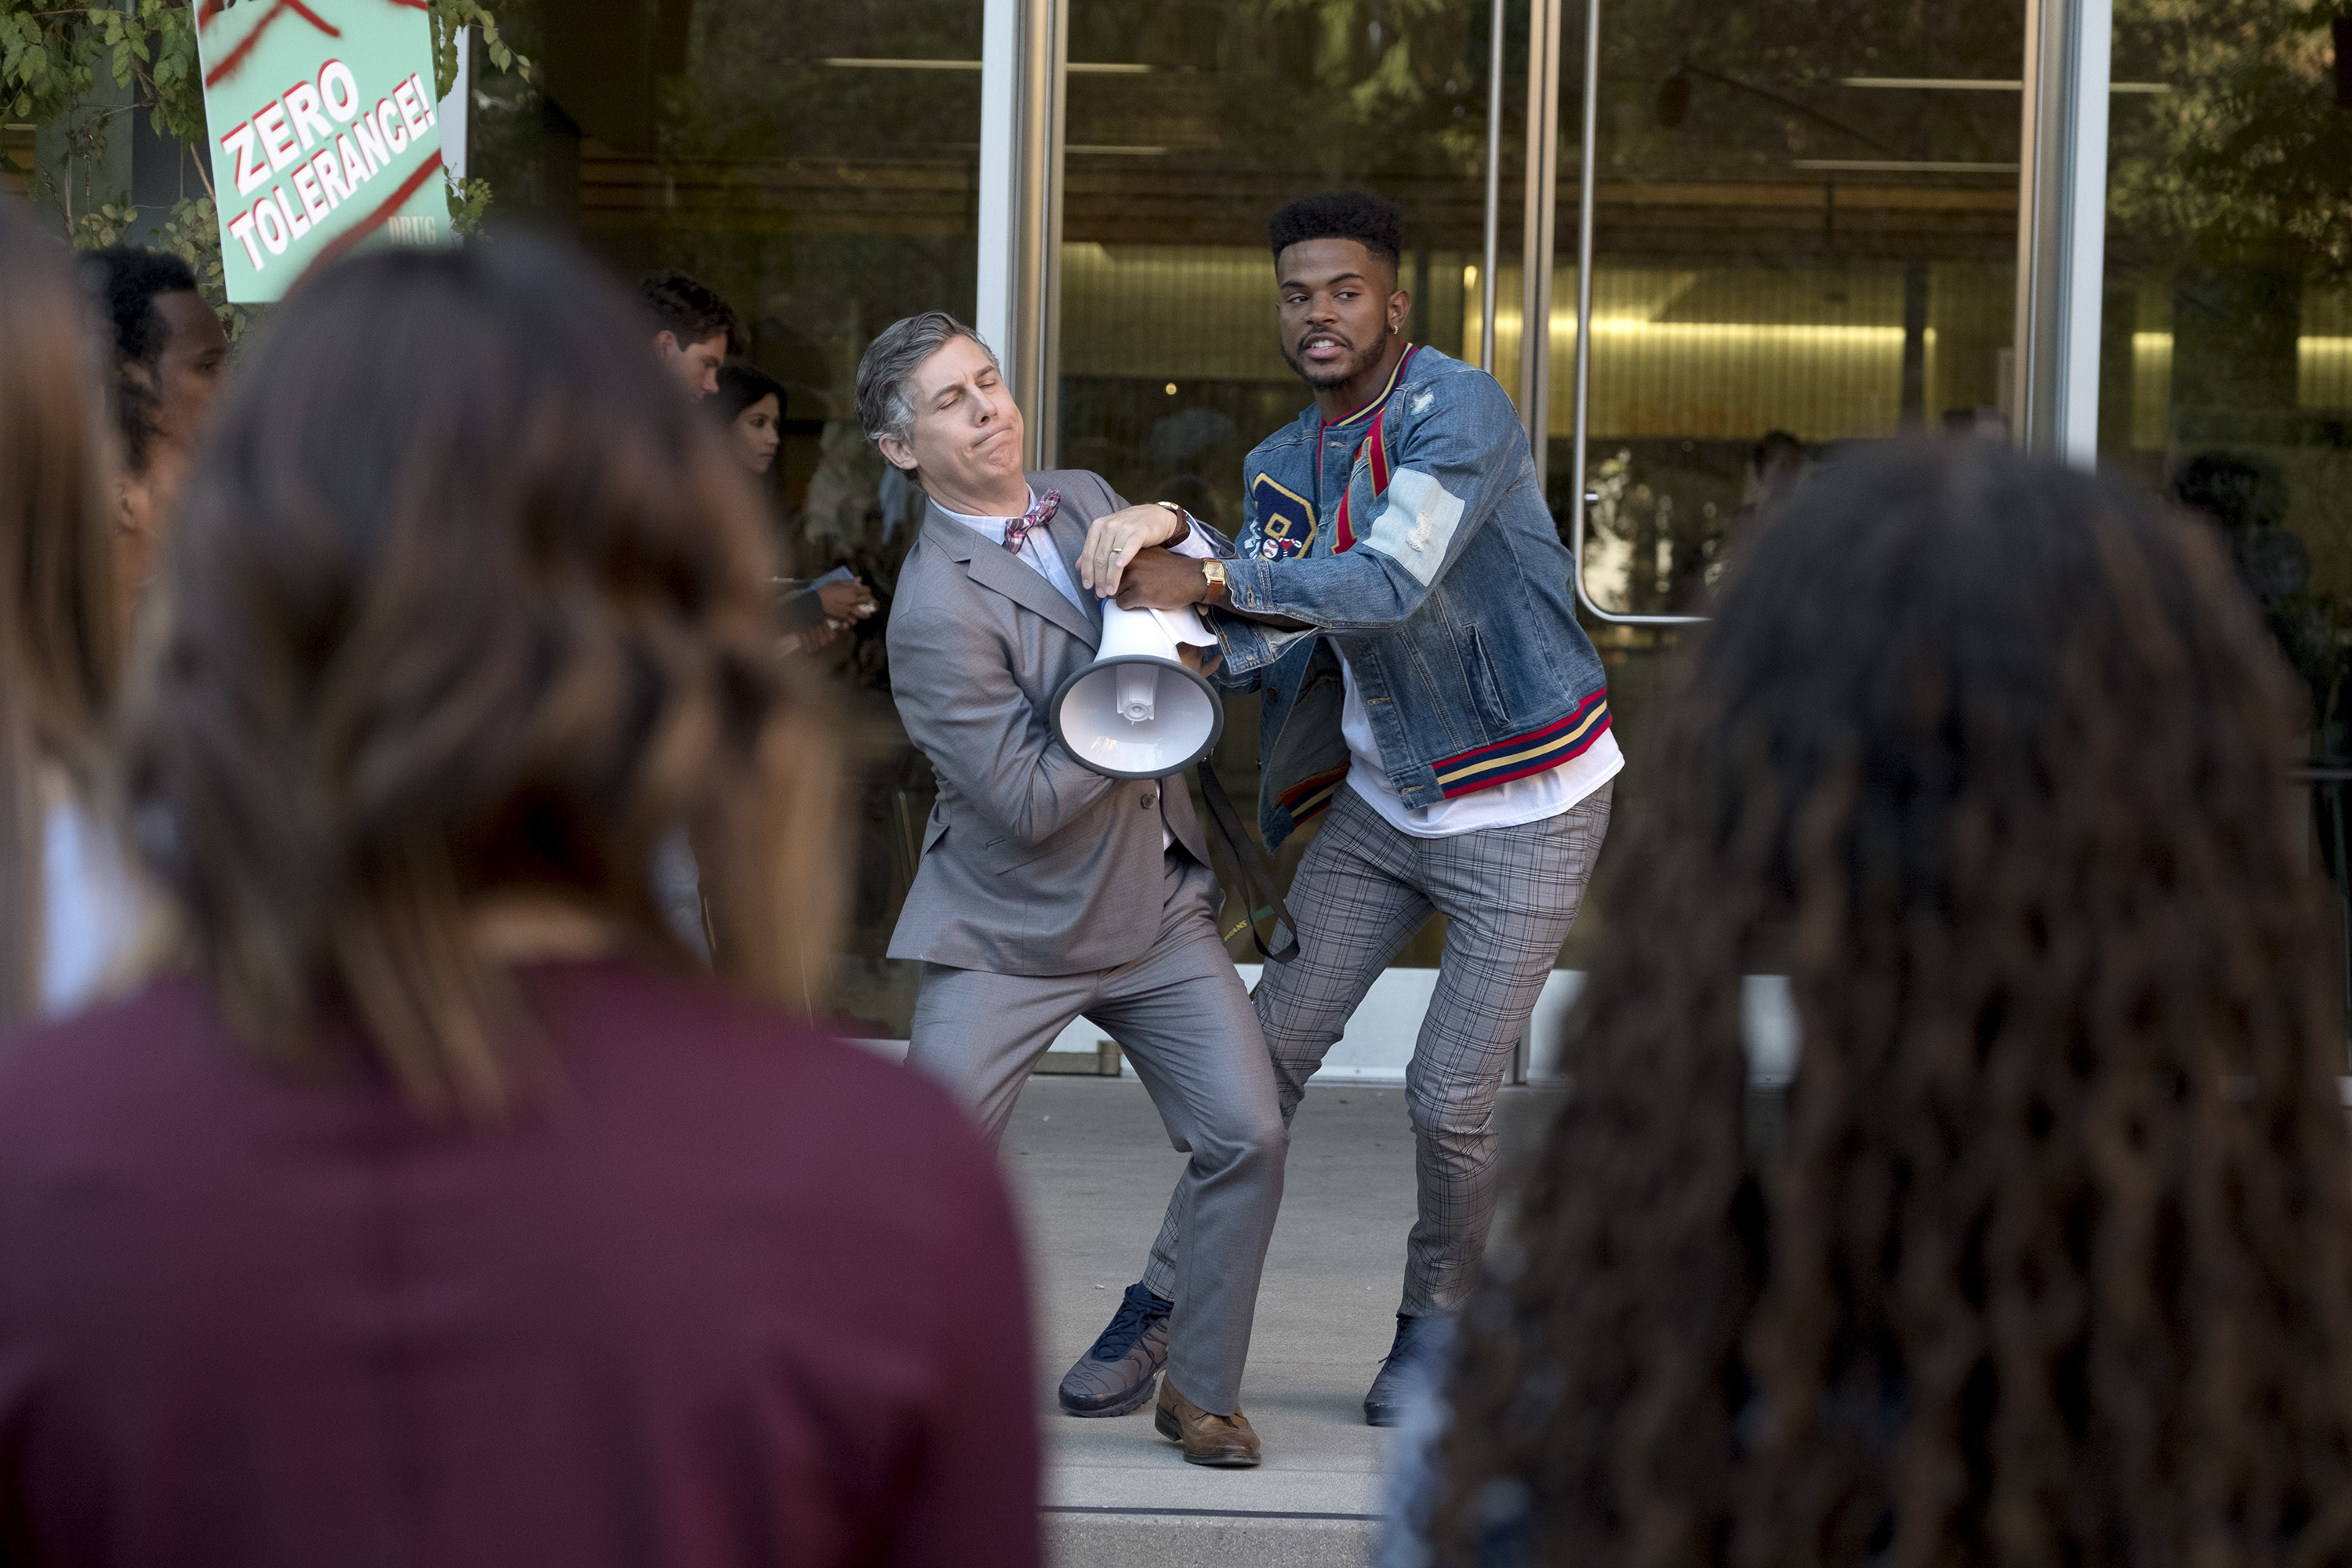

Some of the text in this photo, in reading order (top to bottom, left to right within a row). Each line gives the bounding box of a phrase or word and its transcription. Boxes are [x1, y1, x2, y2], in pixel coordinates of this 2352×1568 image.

[220, 58, 359, 198] ZERO
[227, 72, 436, 272] TOLERANCE!
[387, 216, 437, 245] DRUG
